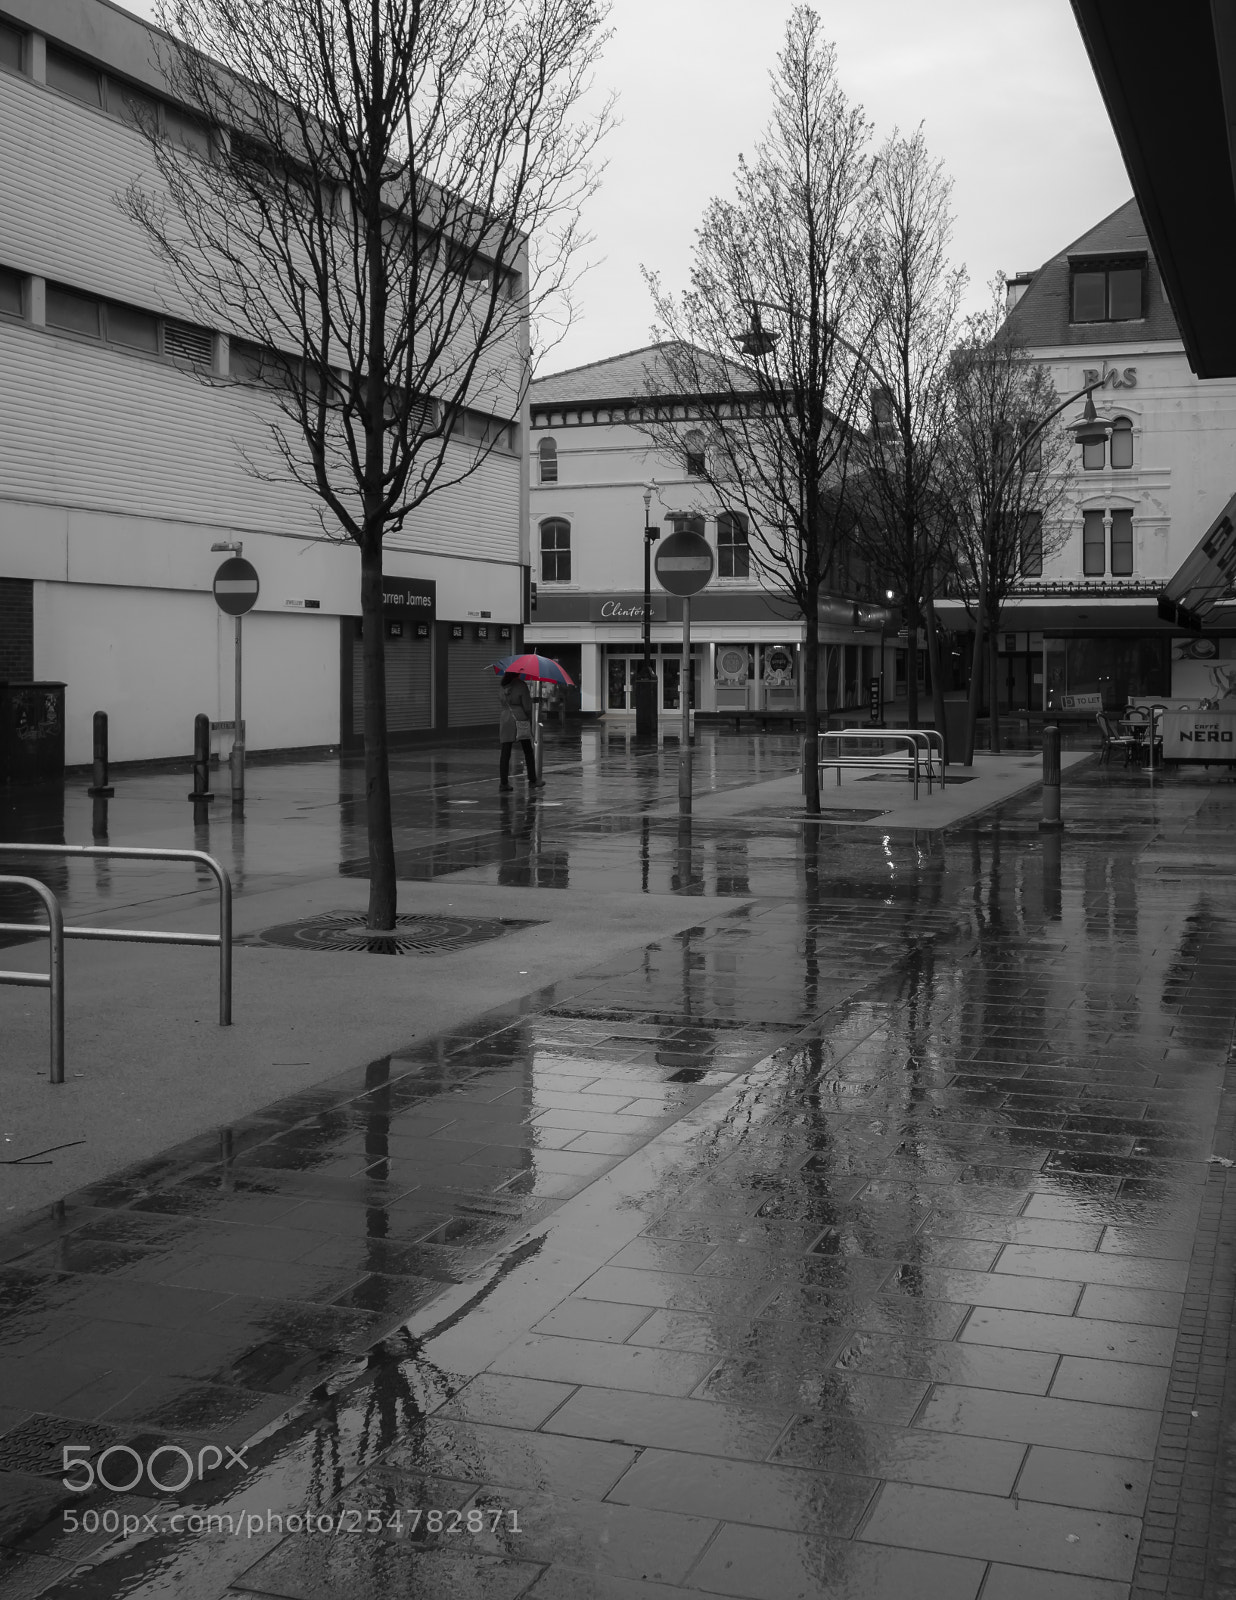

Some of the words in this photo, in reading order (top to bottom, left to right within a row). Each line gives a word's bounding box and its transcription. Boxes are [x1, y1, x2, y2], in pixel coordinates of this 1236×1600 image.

[382, 592, 404, 605] arren
[406, 591, 432, 607] James
[1077, 697, 1087, 705] TO
[1087, 696, 1100, 704] LET
[1179, 730, 1233, 743] NERO
